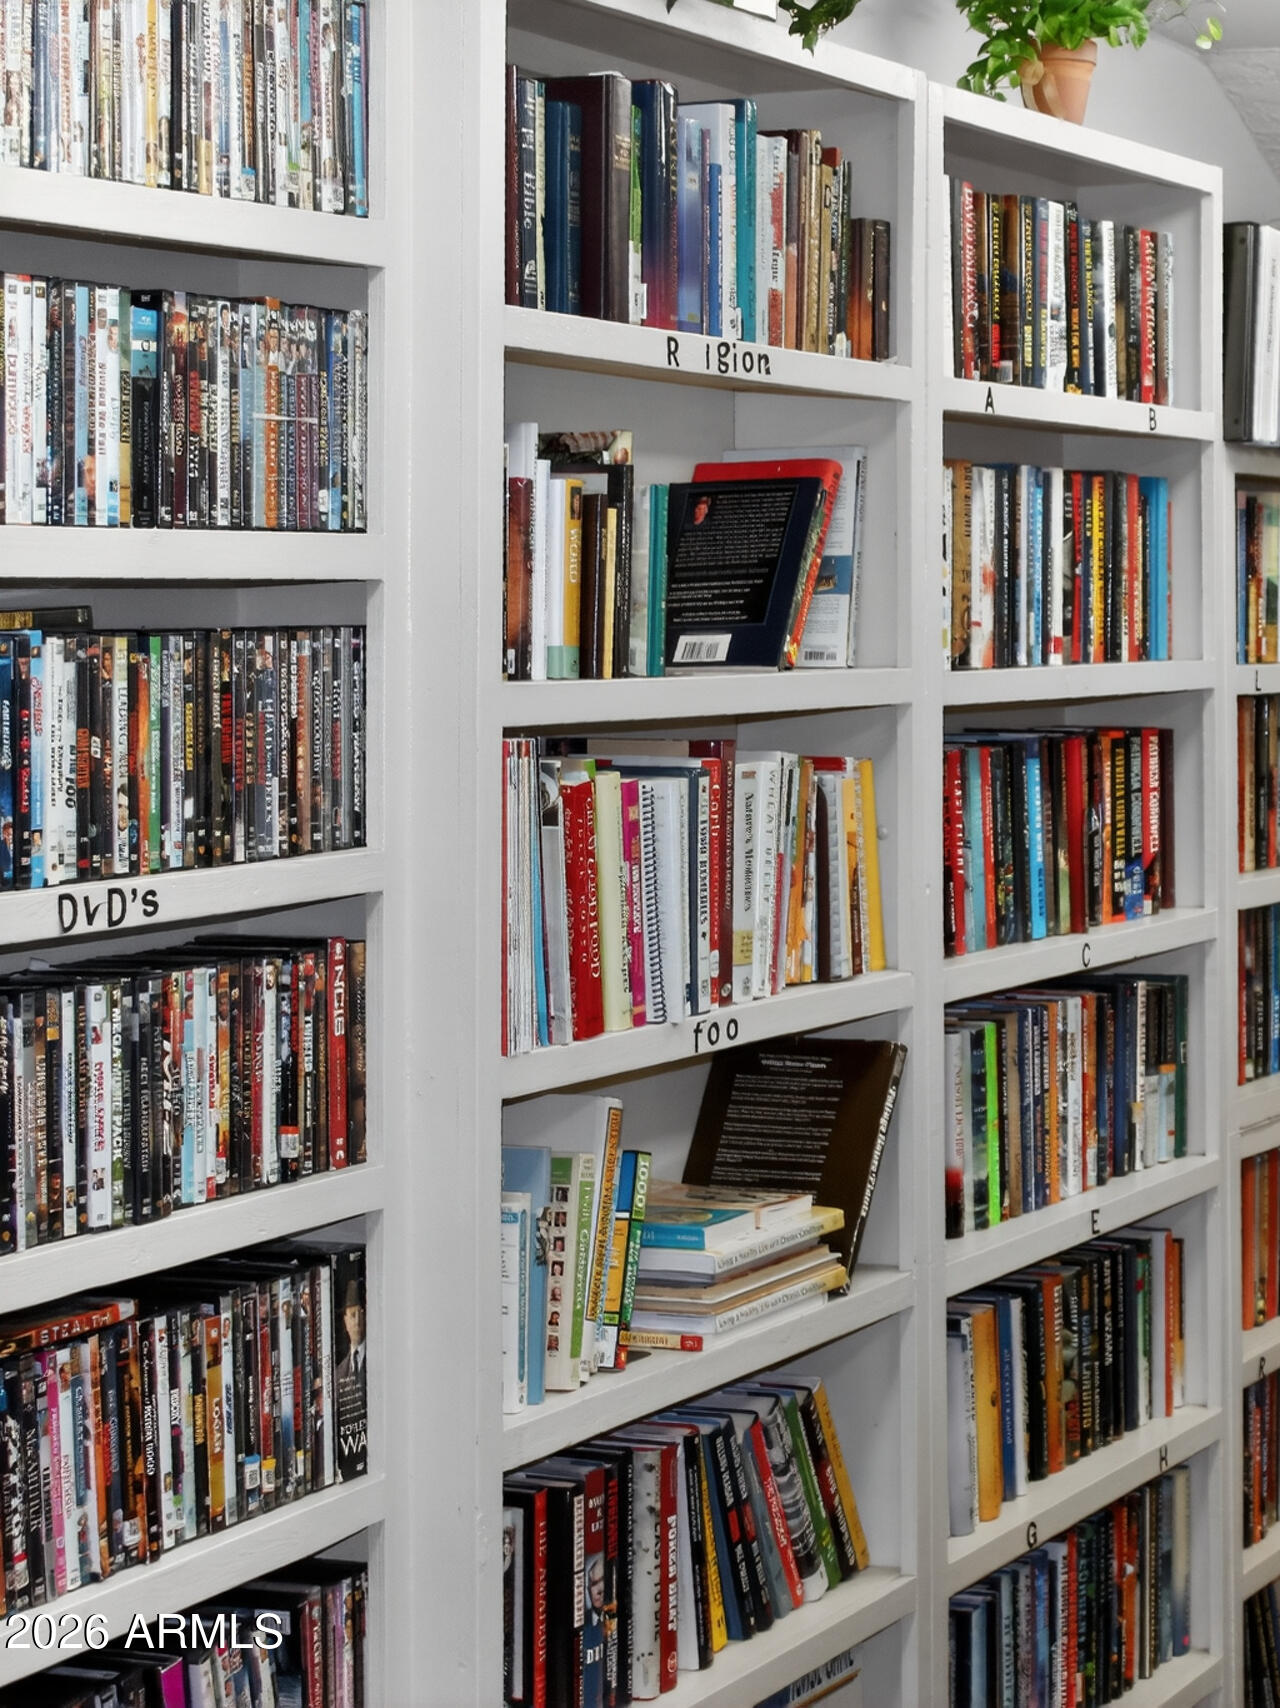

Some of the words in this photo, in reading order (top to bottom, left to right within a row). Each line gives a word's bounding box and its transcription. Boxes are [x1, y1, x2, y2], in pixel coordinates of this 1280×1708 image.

[523, 171, 535, 229] Bible
[984, 386, 995, 414] A
[1150, 408, 1156, 431] B
[1255, 670, 1262, 691] L
[1082, 942, 1090, 968] C
[334, 964, 344, 1036] NCIS
[1091, 1210, 1100, 1234] E
[40, 1310, 111, 1345] STEALTH
[340, 1437, 367, 1456] WA
[1026, 1521, 1037, 1548] G
